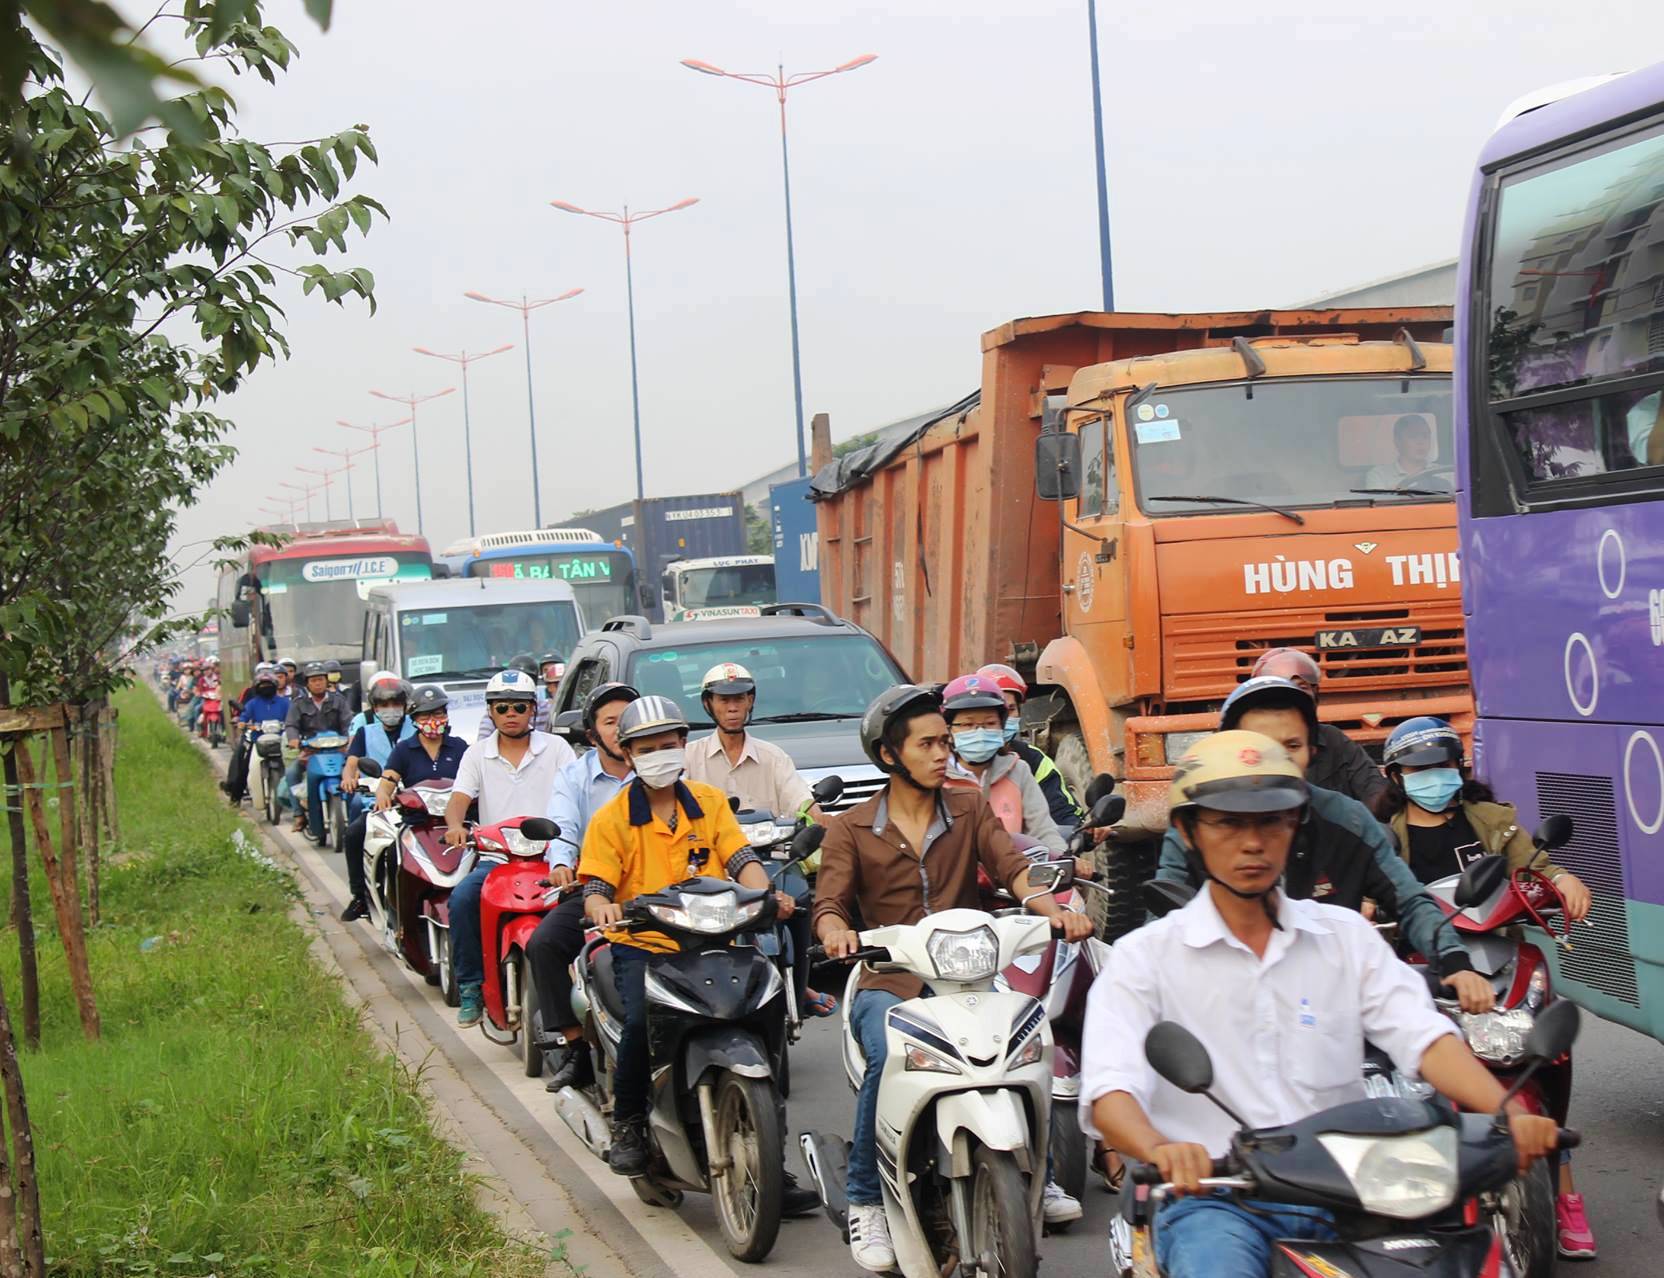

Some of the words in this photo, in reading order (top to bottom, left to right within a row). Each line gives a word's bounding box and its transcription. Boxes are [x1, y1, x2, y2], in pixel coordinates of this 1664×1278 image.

[558, 558, 595, 579] TÂN
[1243, 555, 1354, 594] HÙNG
[1319, 632, 1358, 648] KA
[1379, 628, 1417, 645] AZ
